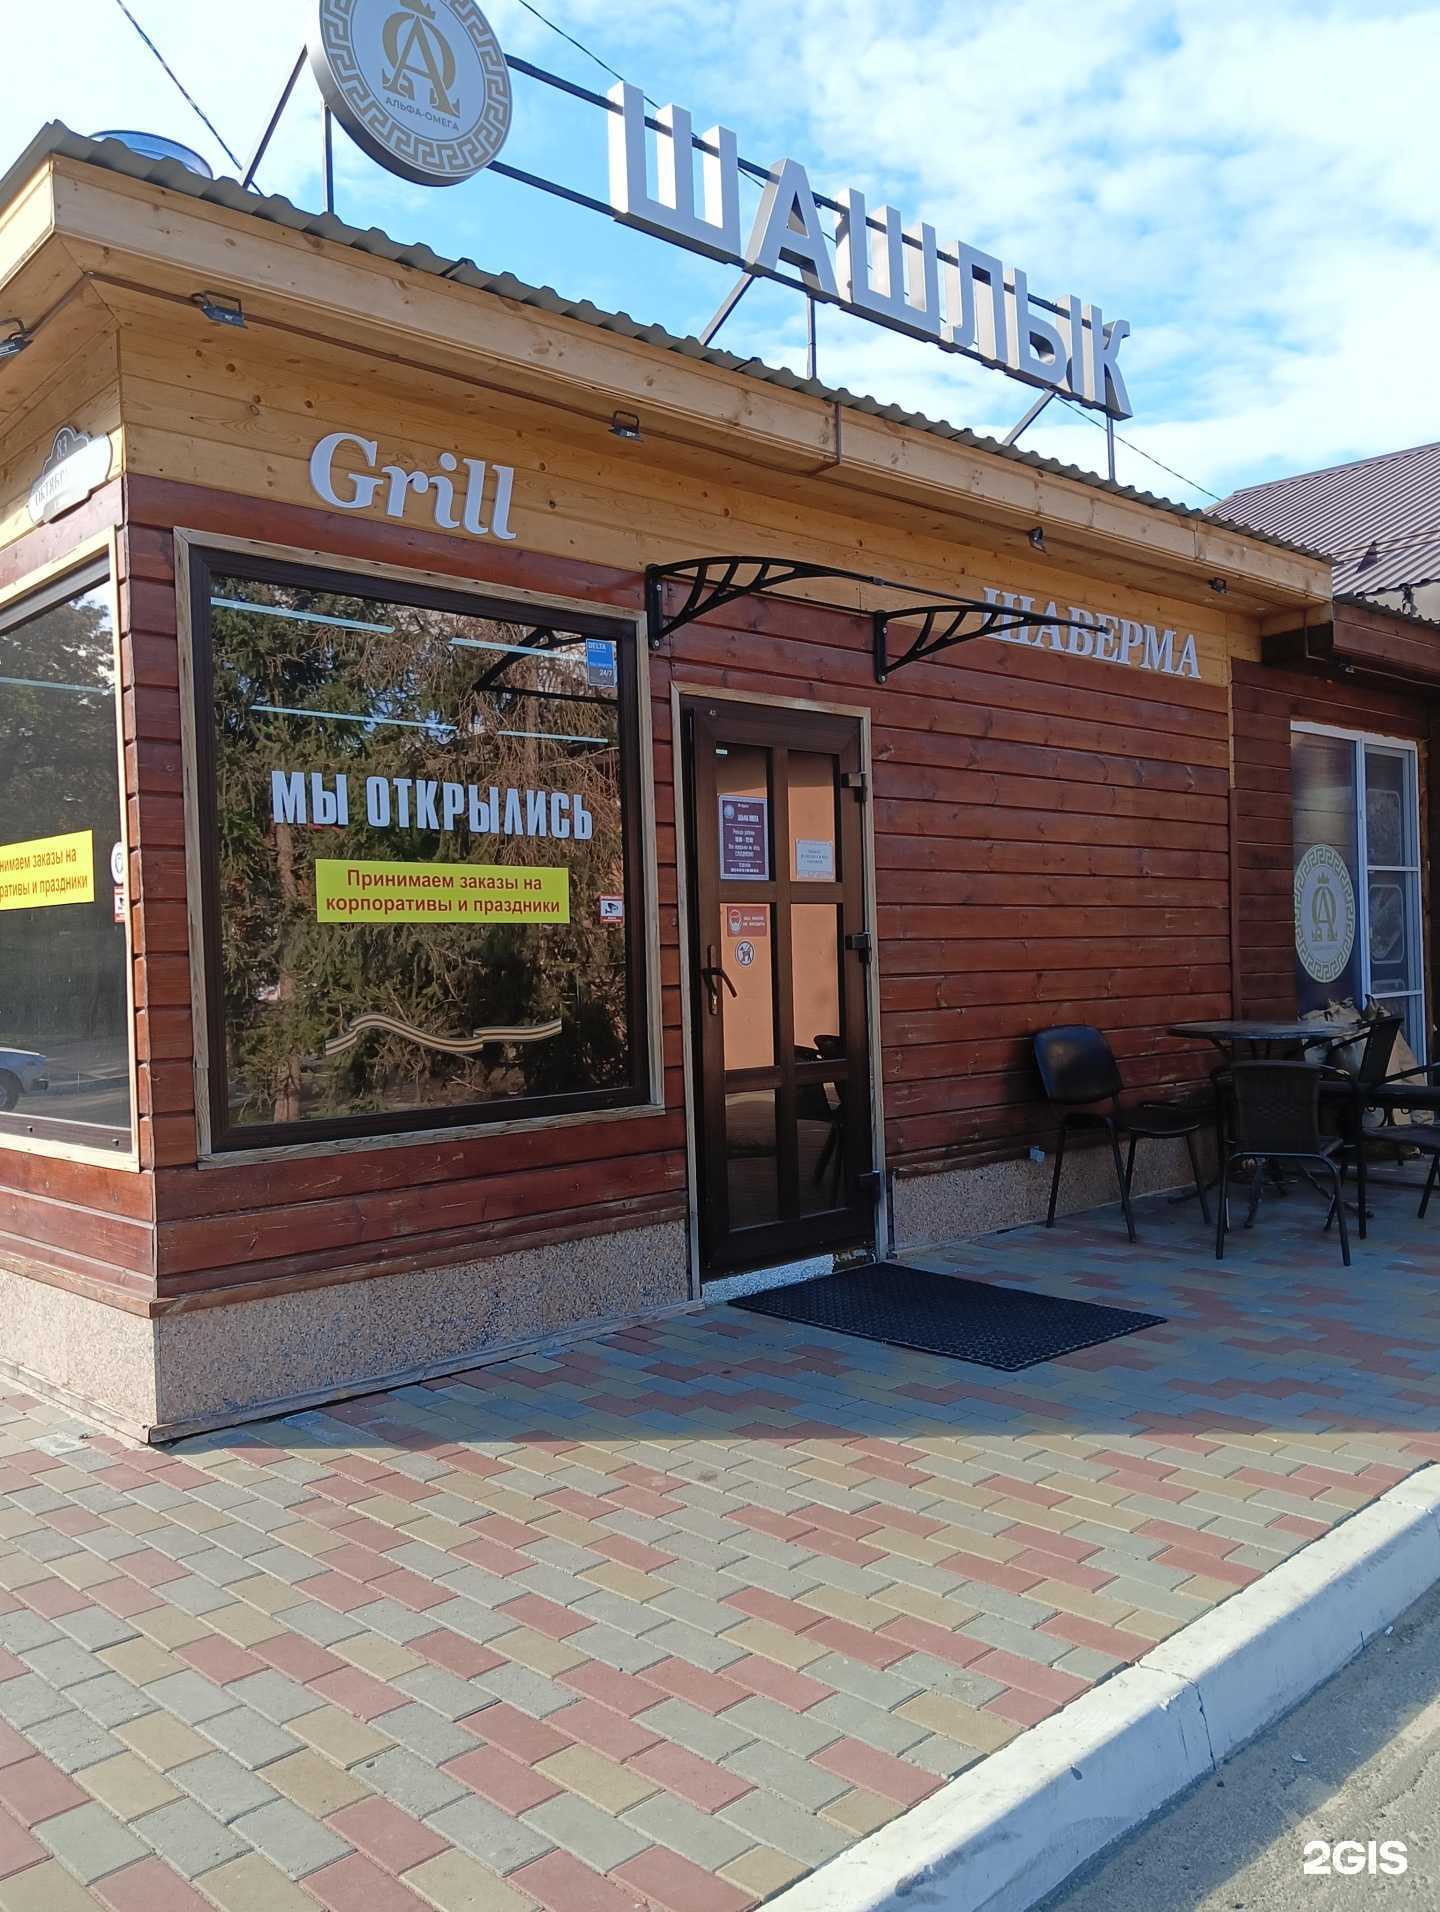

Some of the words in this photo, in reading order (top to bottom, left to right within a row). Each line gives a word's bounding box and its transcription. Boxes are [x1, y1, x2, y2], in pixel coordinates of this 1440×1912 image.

[386, 97, 459, 130] АЛЬФА-ОМЕГА
[607, 80, 1134, 419] ШАШЛЫК
[309, 432, 517, 540] Grill
[983, 587, 1201, 679] ШАВЕРМА
[271, 770, 349, 825] МЫ
[366, 776, 593, 840] ОТКРЫЛИСЬ
[32, 851, 63, 867] заказы
[65, 848, 77, 862] на
[32, 881, 38, 894] и
[40, 875, 88, 897] праздники
[347, 869, 454, 891] Принимаем
[459, 877, 519, 890] заказы
[524, 879, 542, 890] на
[326, 896, 452, 916] корпоративы
[458, 900, 468, 911] и
[473, 900, 560, 916] праздники
